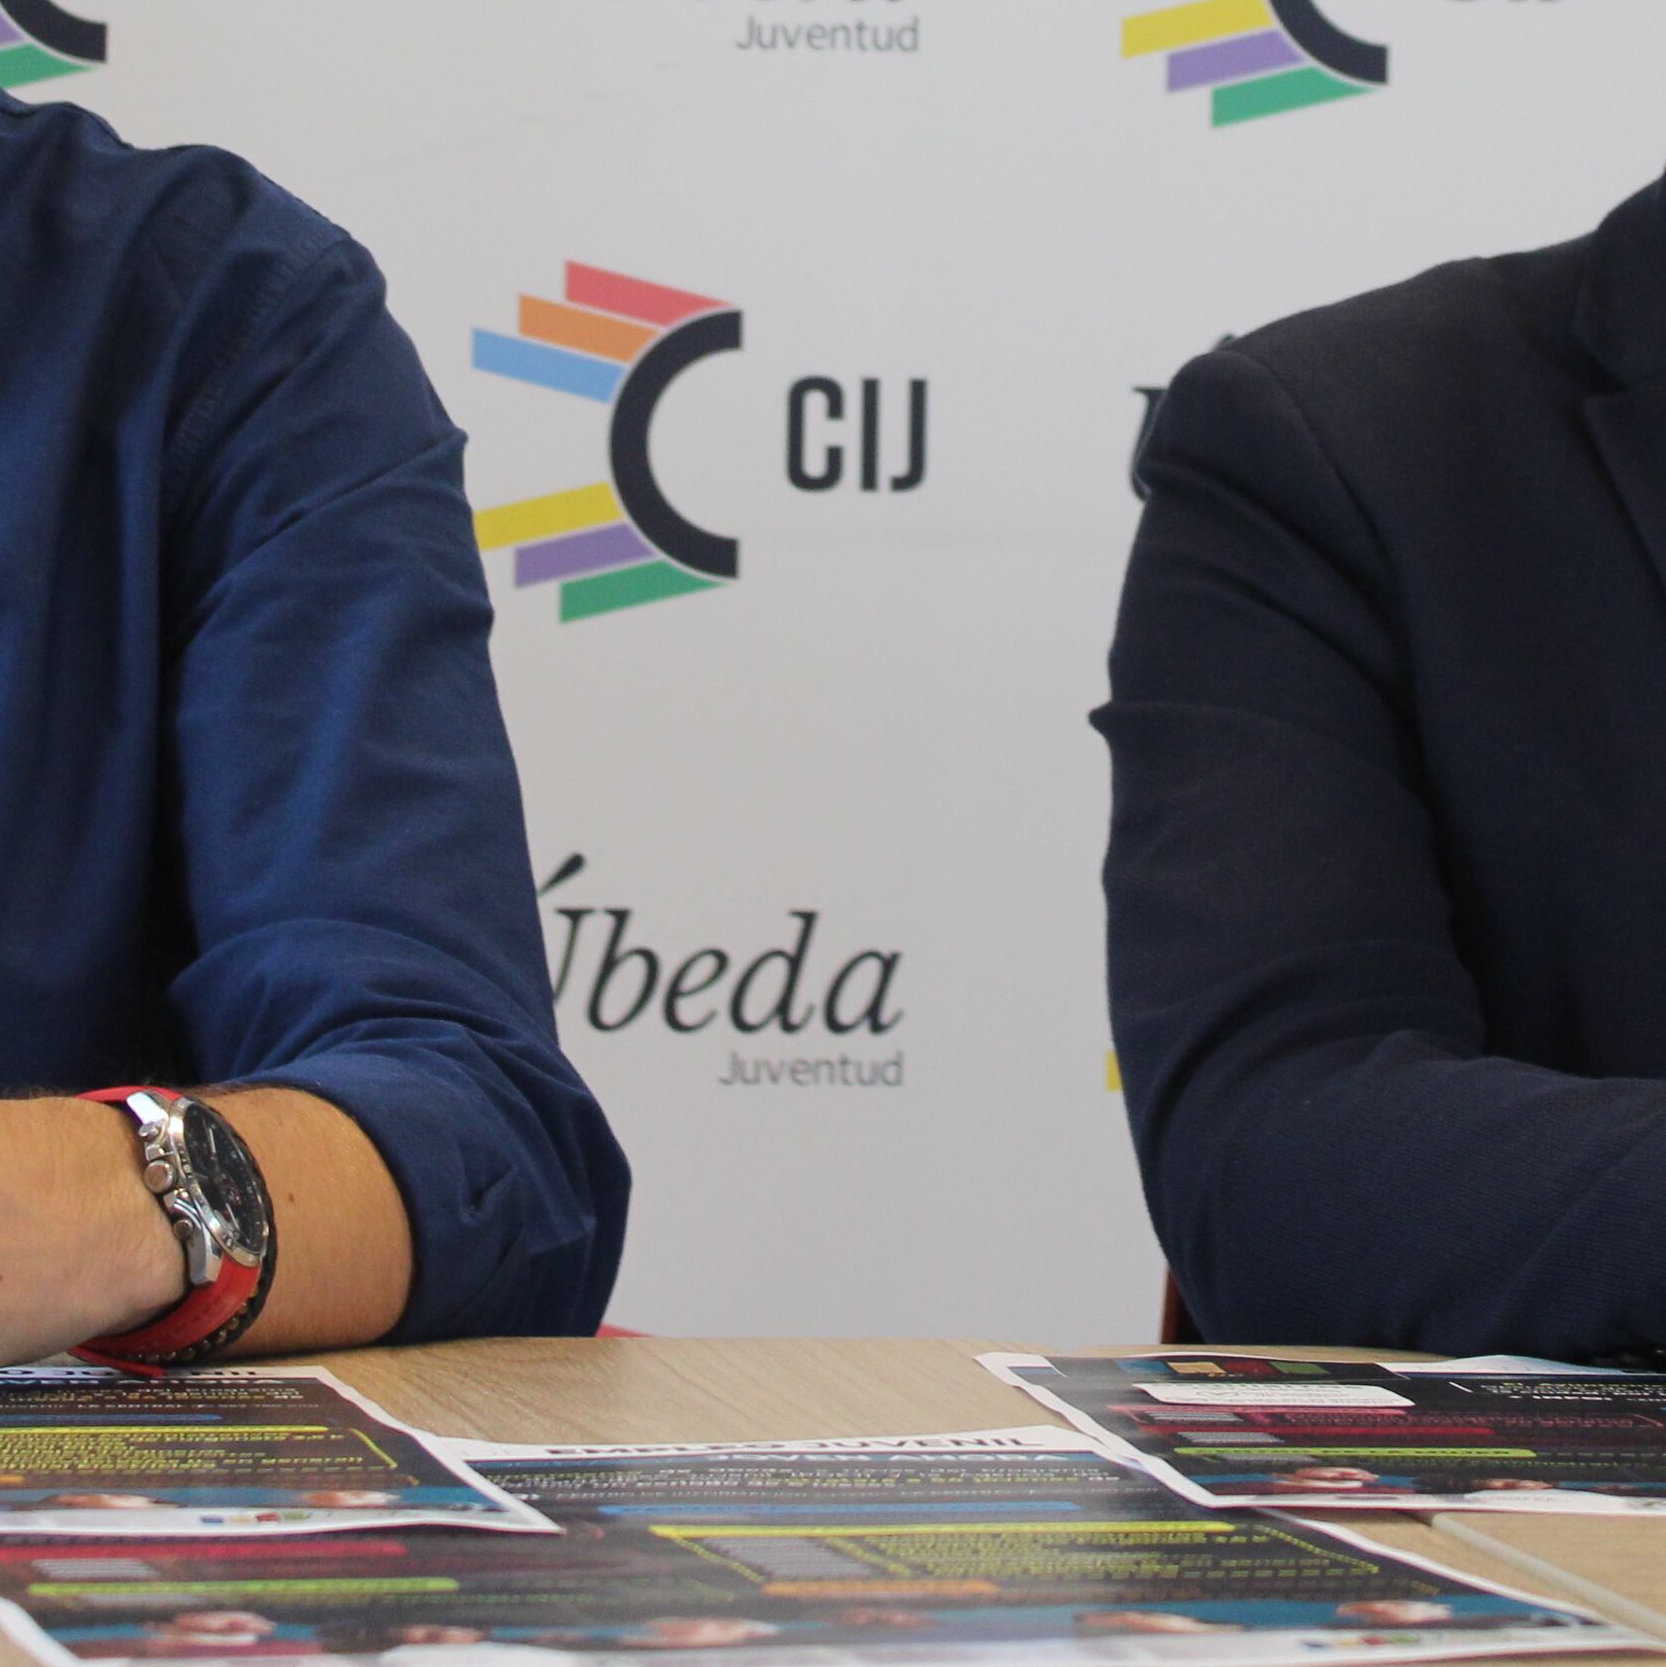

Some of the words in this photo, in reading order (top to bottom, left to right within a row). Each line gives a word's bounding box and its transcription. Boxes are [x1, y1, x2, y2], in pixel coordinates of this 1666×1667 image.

[735, 14, 920, 53] Juventud
[786, 375, 928, 493] CIJ
[719, 1050, 904, 1088] Juventud
[802, 1437, 1043, 1450] JUVENIL
